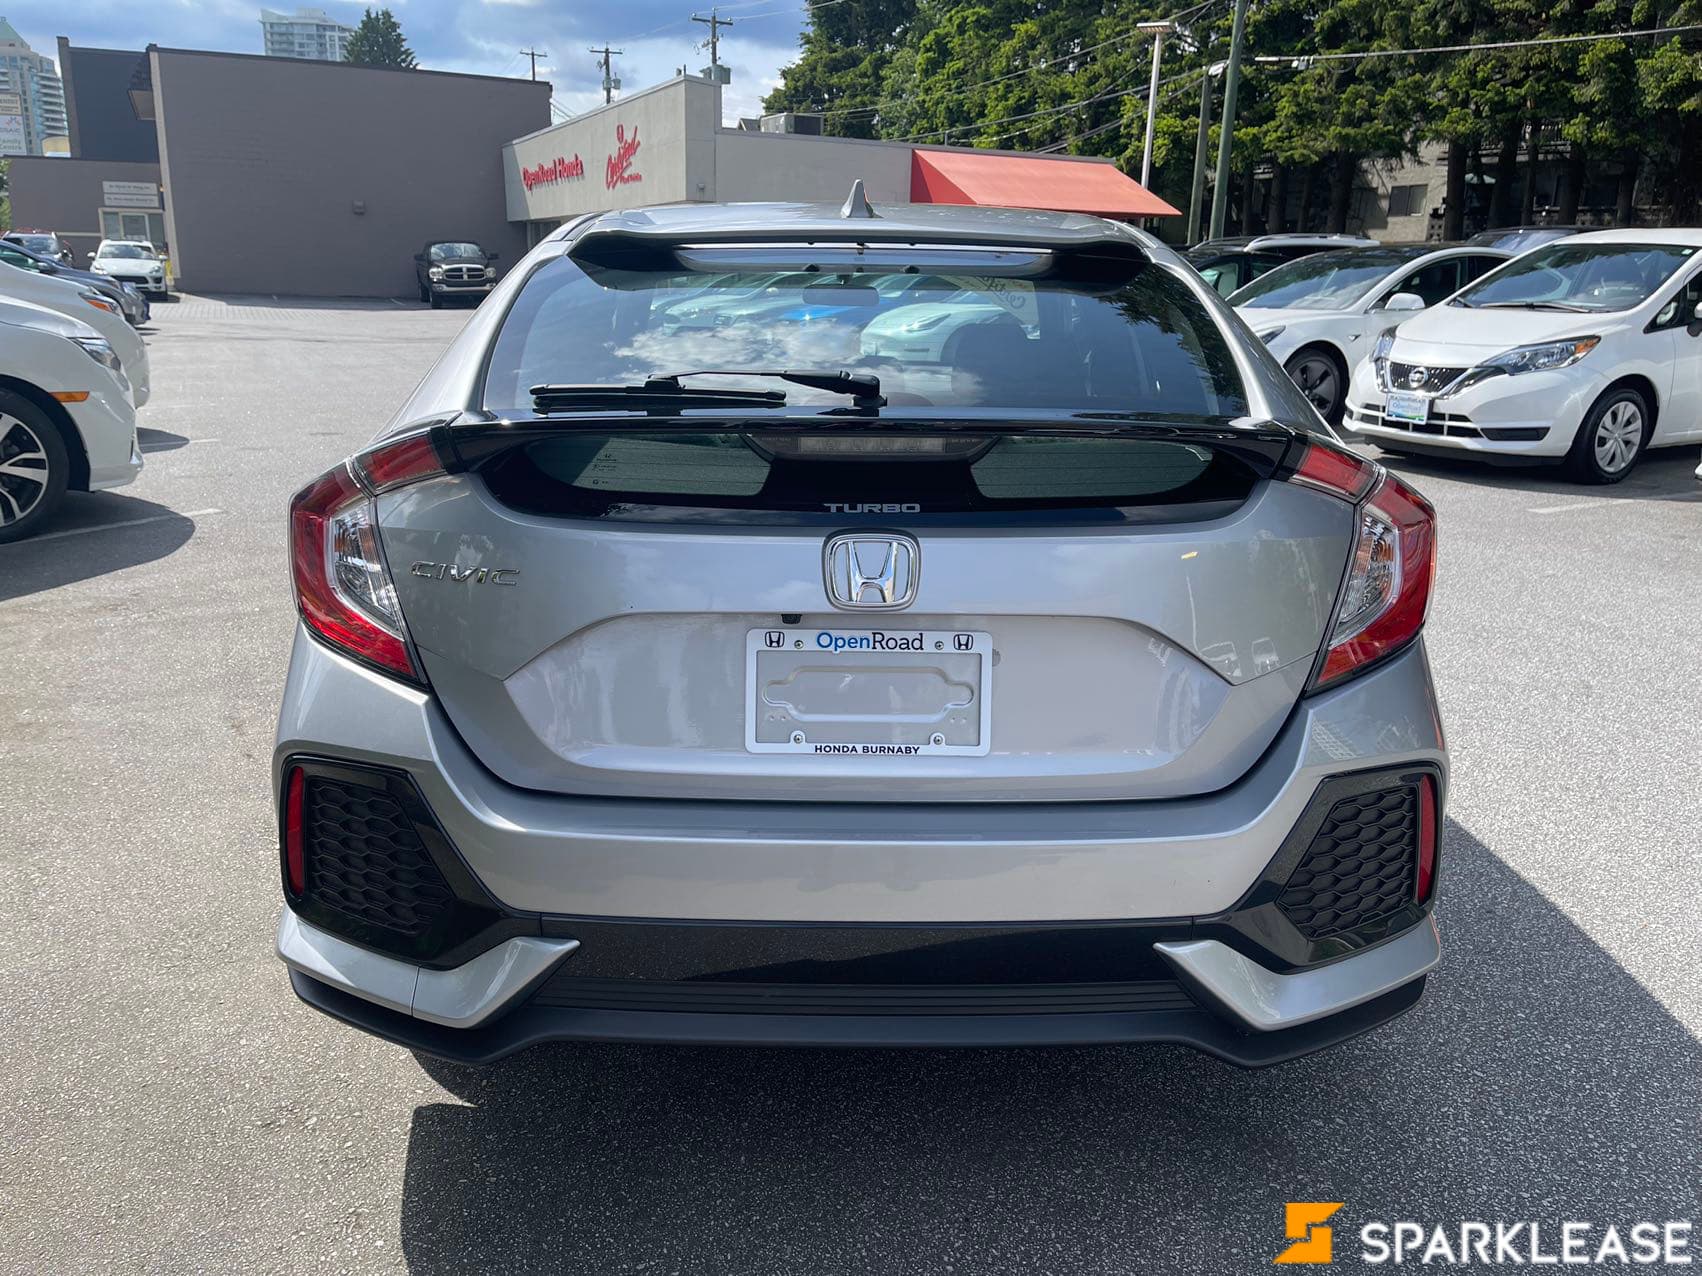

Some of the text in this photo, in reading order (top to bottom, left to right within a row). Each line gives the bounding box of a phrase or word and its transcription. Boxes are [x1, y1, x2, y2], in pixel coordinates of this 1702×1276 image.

[522, 153, 583, 191] OpenRoad Honda
[824, 503, 920, 513] TURBO
[410, 560, 520, 586] CIVIC
[816, 632, 924, 651] OpenRoad
[815, 744, 920, 755] HONDA BURNABY
